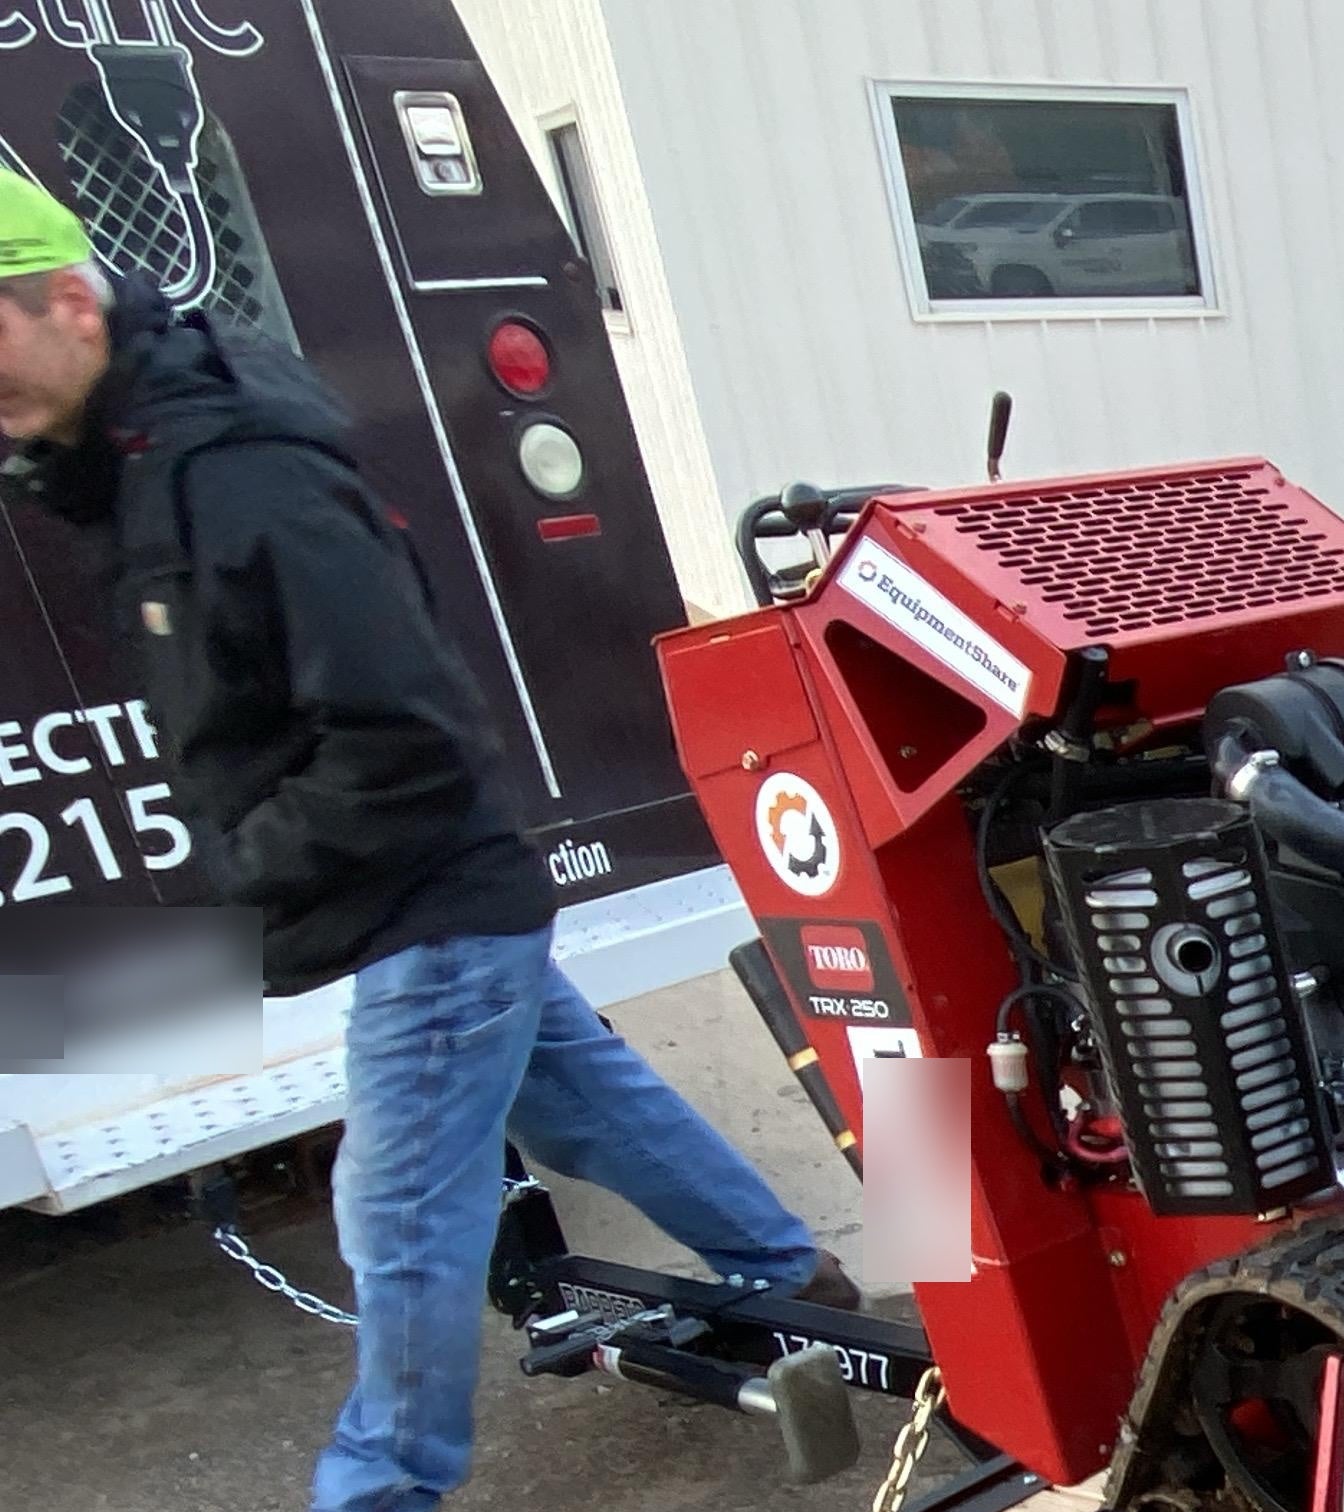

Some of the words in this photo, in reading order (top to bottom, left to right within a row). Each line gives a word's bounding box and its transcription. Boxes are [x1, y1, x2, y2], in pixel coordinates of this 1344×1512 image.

[877, 574, 1018, 692] EquipmentShare
[807, 945, 868, 972] TORO
[809, 996, 847, 1016] TRX
[850, 999, 889, 1018] 250
[772, 1331, 889, 1390] 17977
